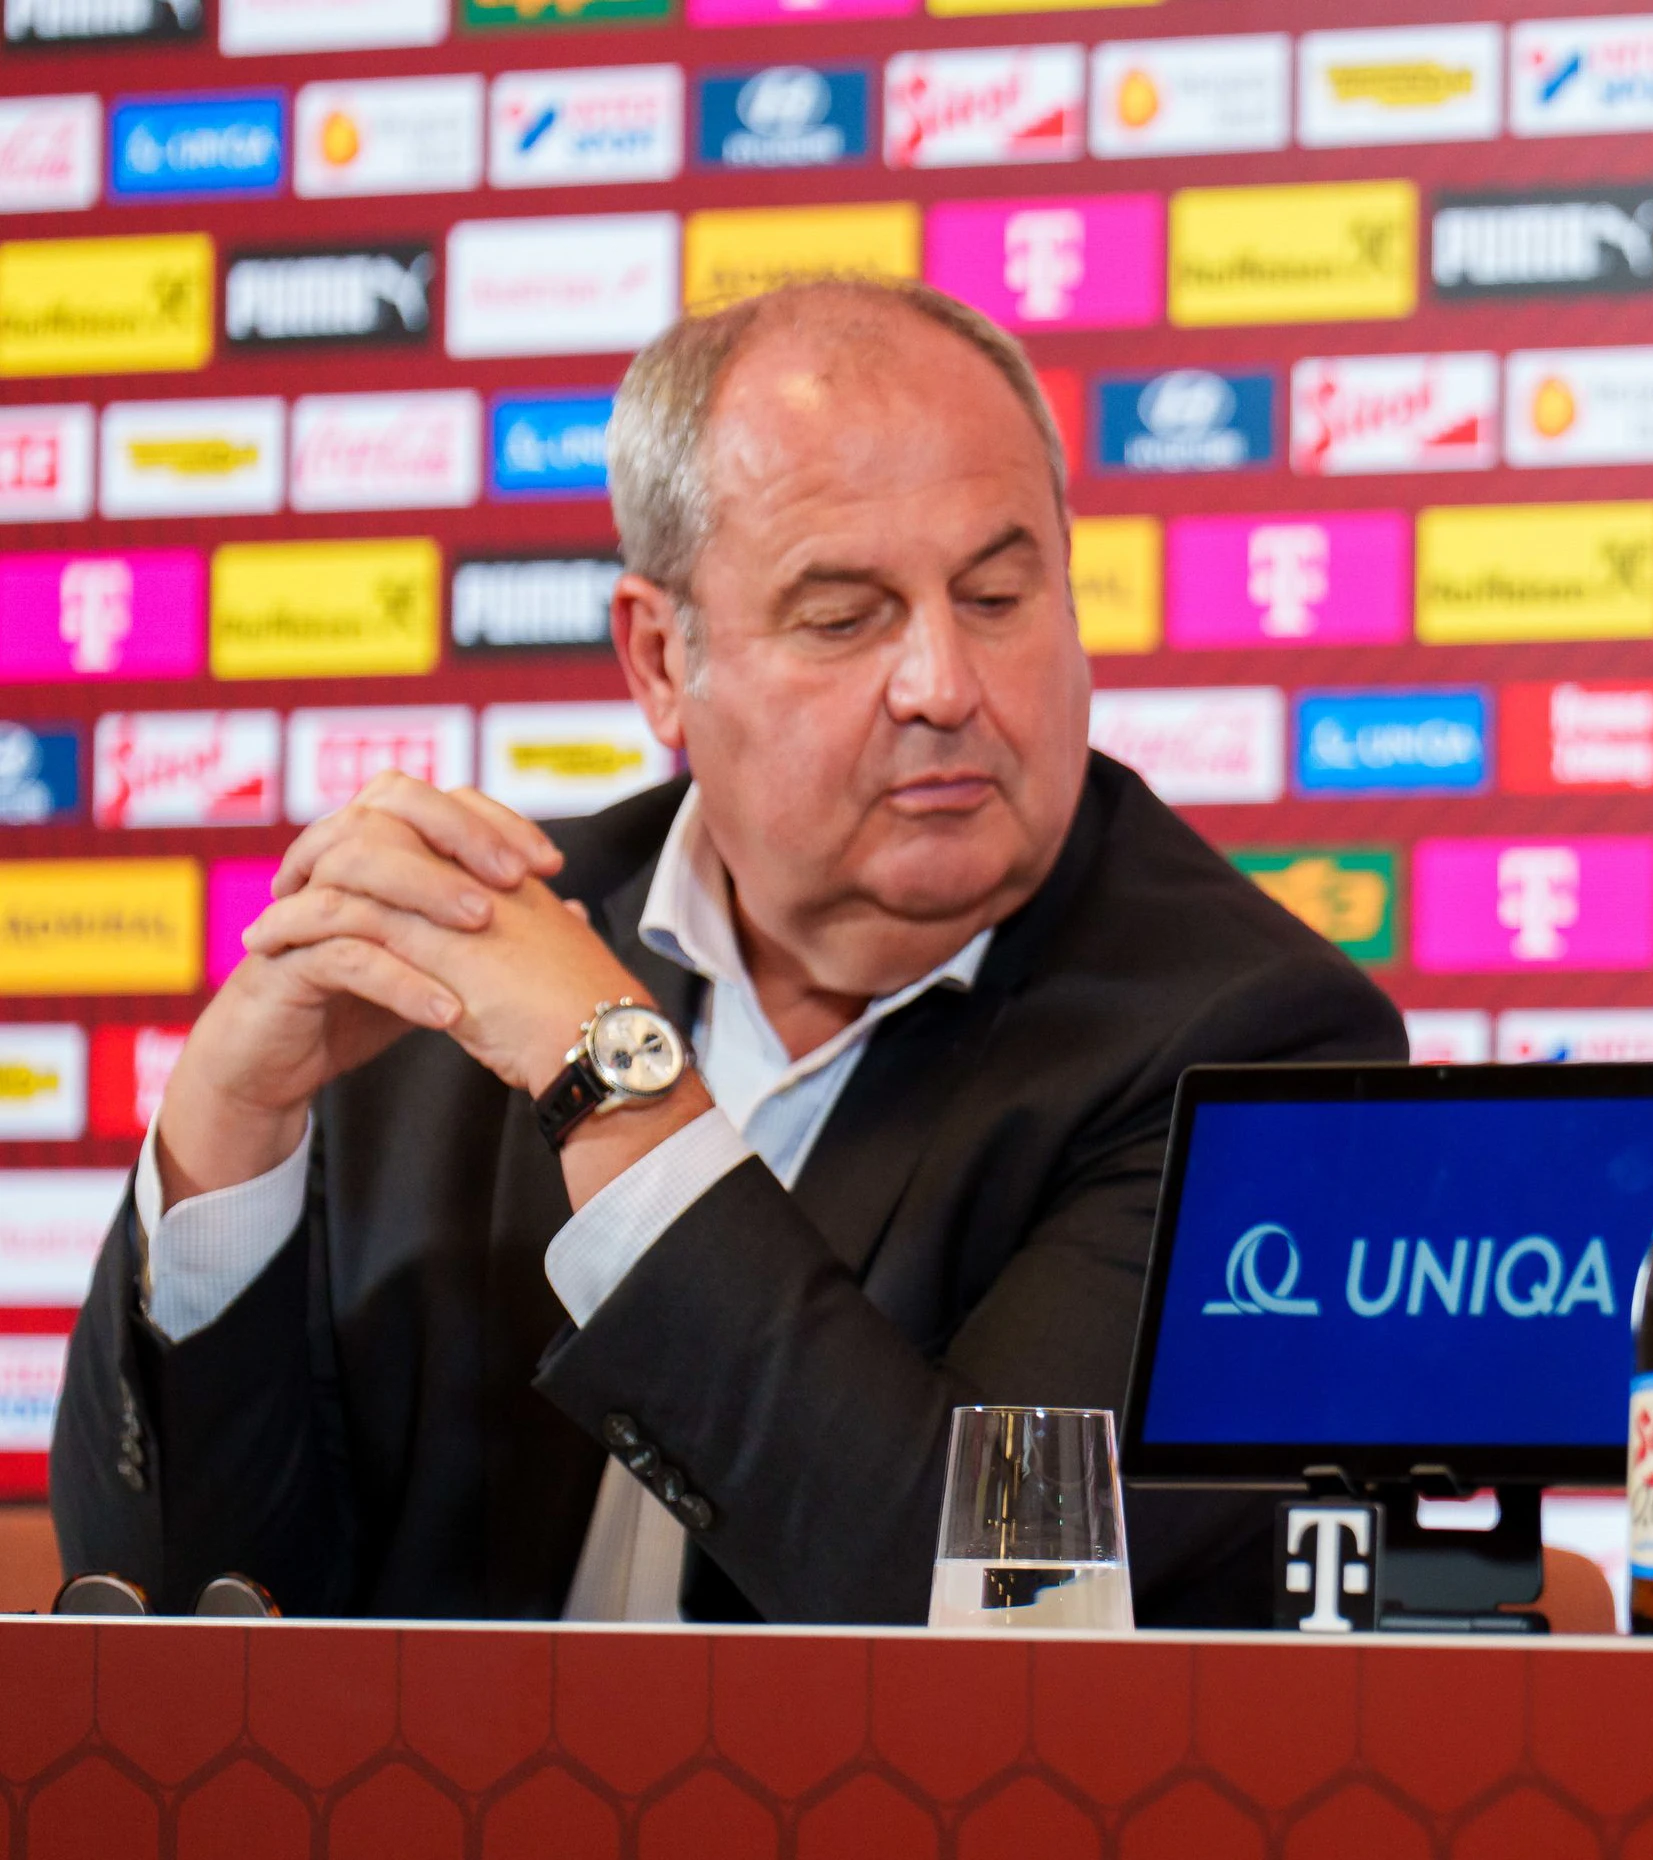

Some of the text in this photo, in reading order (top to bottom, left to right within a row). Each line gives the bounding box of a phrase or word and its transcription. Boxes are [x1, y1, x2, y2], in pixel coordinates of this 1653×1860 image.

[1433, 202, 1604, 288] PUMA
[226, 255, 382, 341] PUMA
[1346, 1235, 1617, 1317] UNIQA
[1286, 1508, 1371, 1633] T
